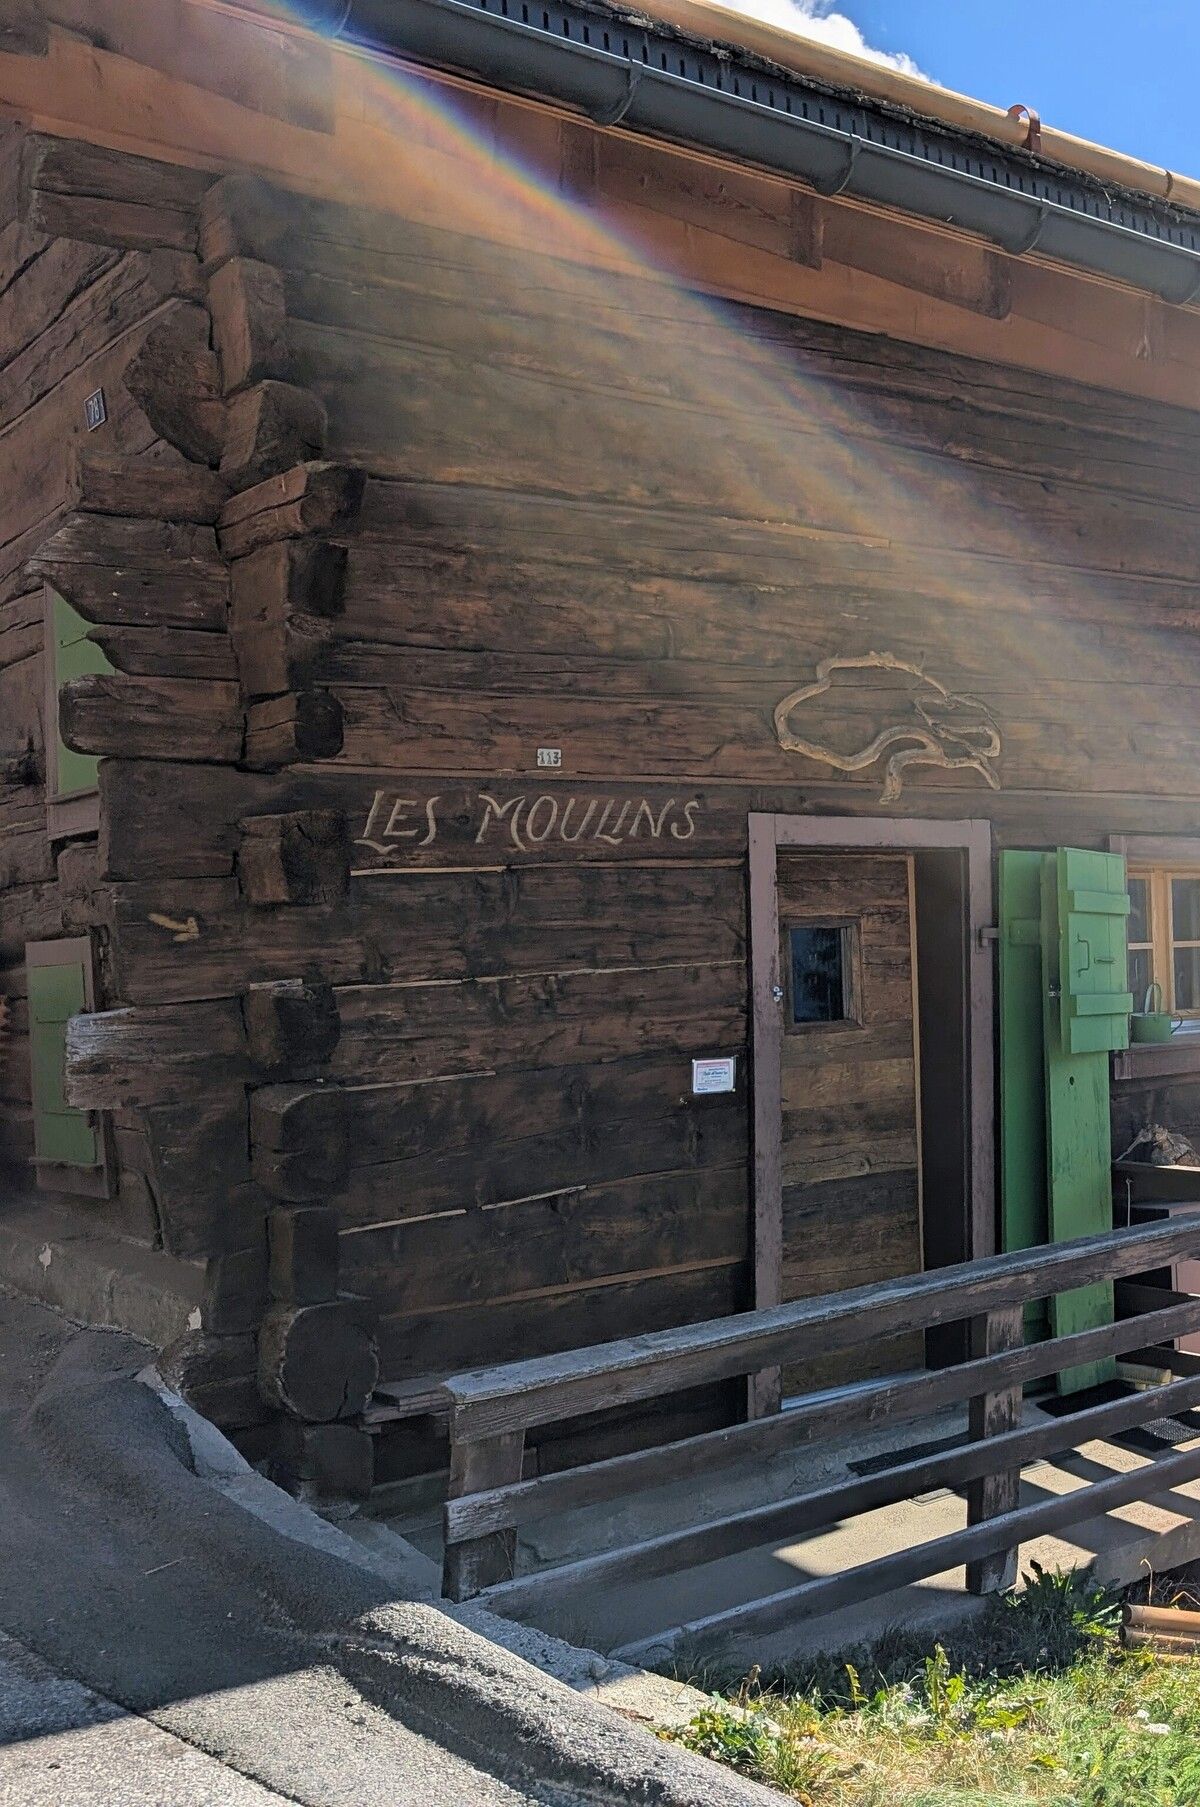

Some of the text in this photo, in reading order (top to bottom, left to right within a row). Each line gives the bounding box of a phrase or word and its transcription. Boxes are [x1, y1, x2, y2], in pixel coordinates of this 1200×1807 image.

[539, 751, 559, 765] 113
[353, 790, 700, 853] LES MOULINS
